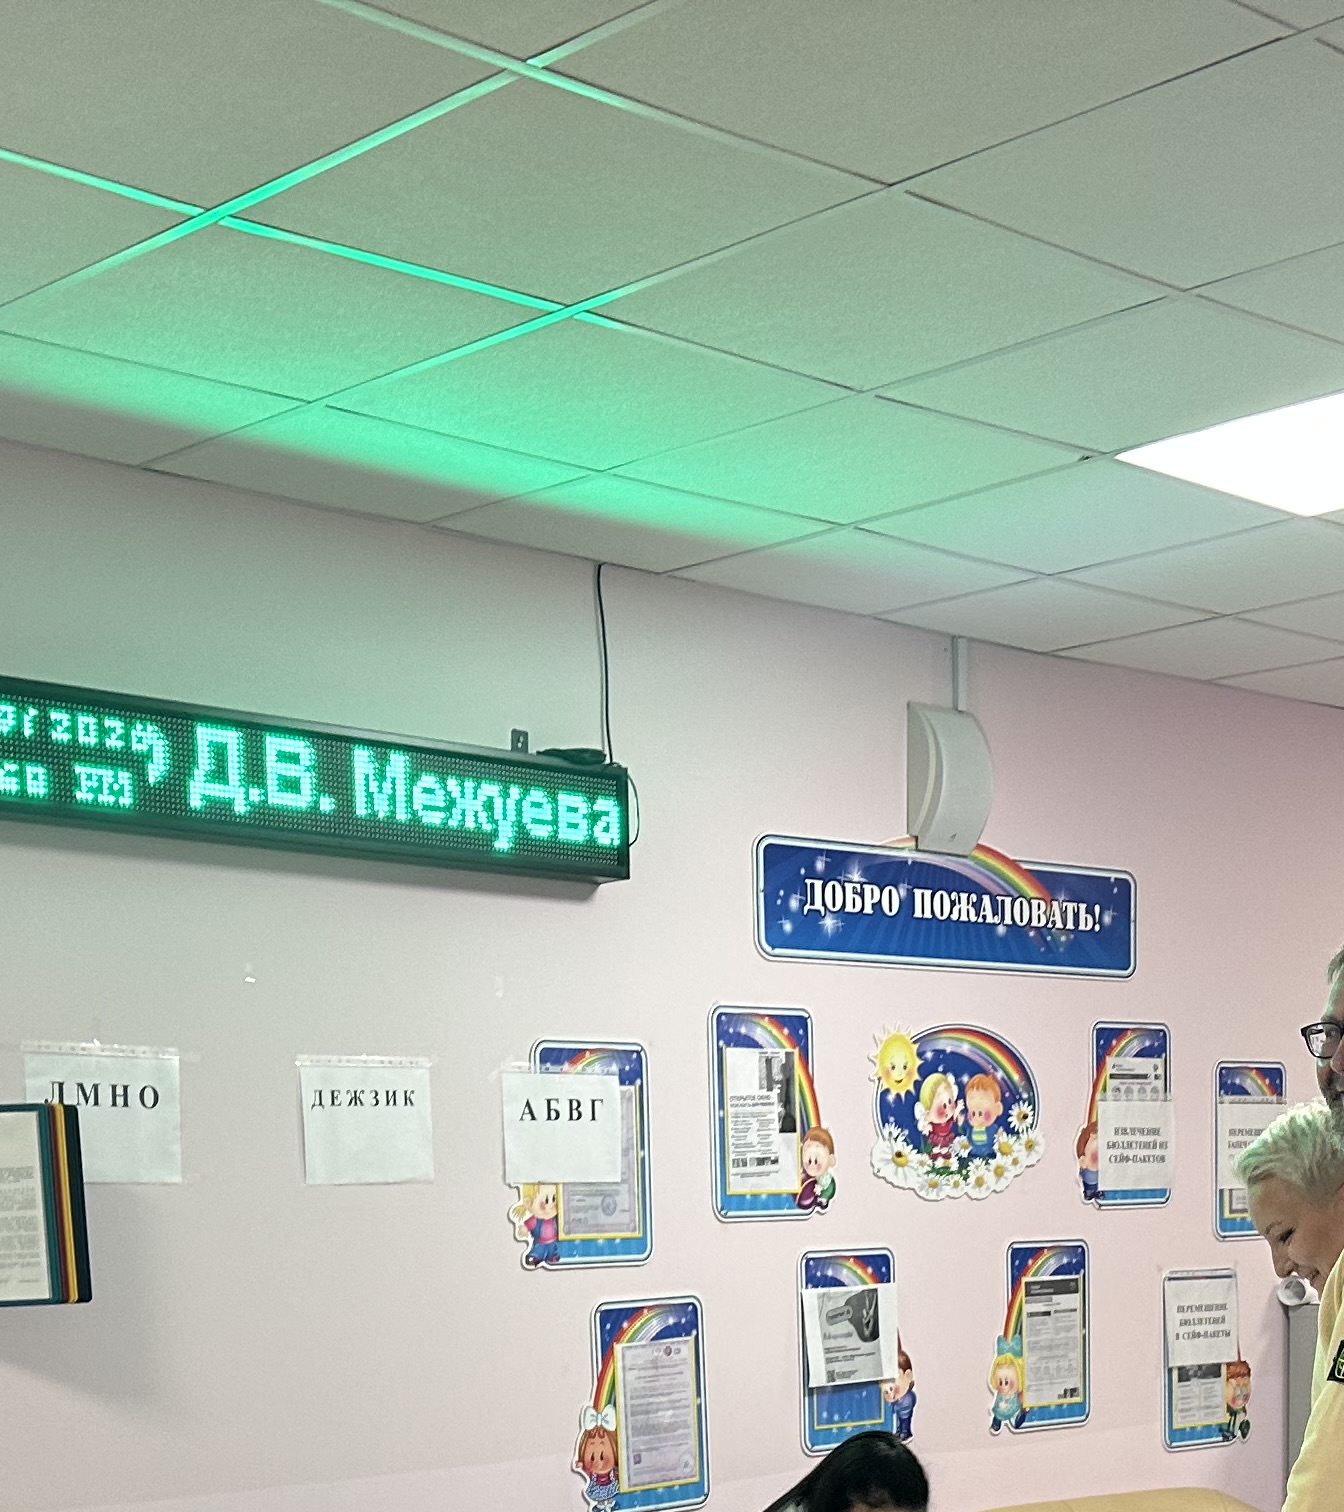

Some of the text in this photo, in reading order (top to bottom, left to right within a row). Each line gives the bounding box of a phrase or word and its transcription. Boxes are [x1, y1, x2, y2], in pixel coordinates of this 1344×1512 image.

[189, 722, 622, 853] Д.В. Межуева
[803, 878, 1102, 932] ДОБРО ПОЖАЛОВАТЬ!
